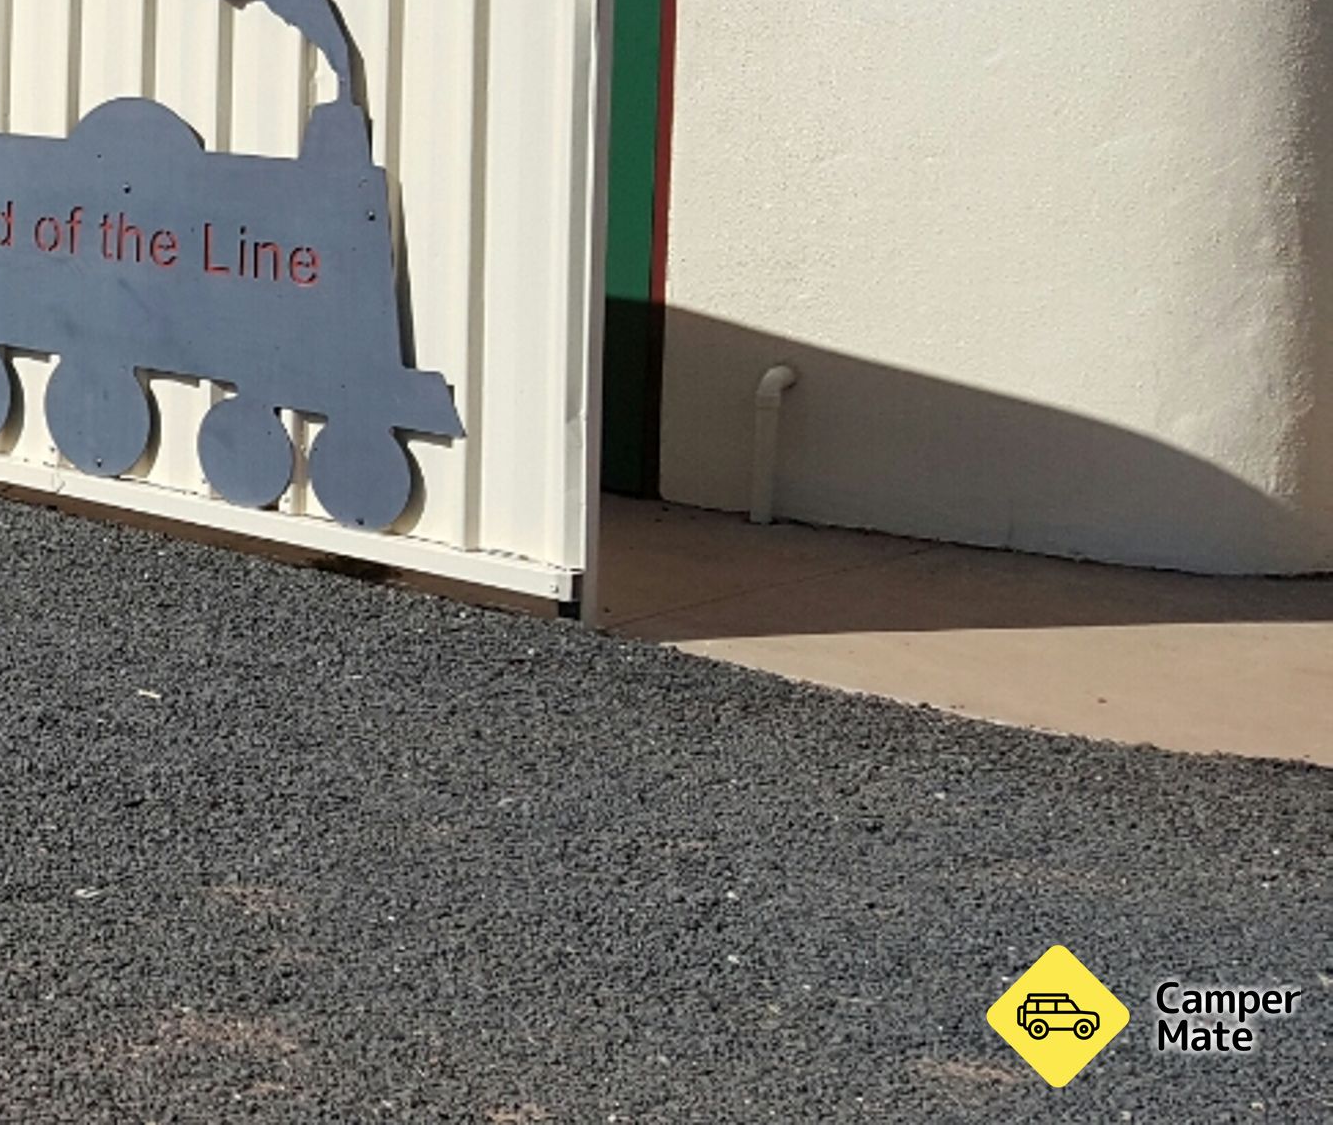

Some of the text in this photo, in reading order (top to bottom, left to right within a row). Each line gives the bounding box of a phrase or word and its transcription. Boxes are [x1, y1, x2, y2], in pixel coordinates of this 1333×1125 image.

[34, 206, 84, 255] of
[100, 212, 179, 267] the
[203, 222, 321, 287] Line
